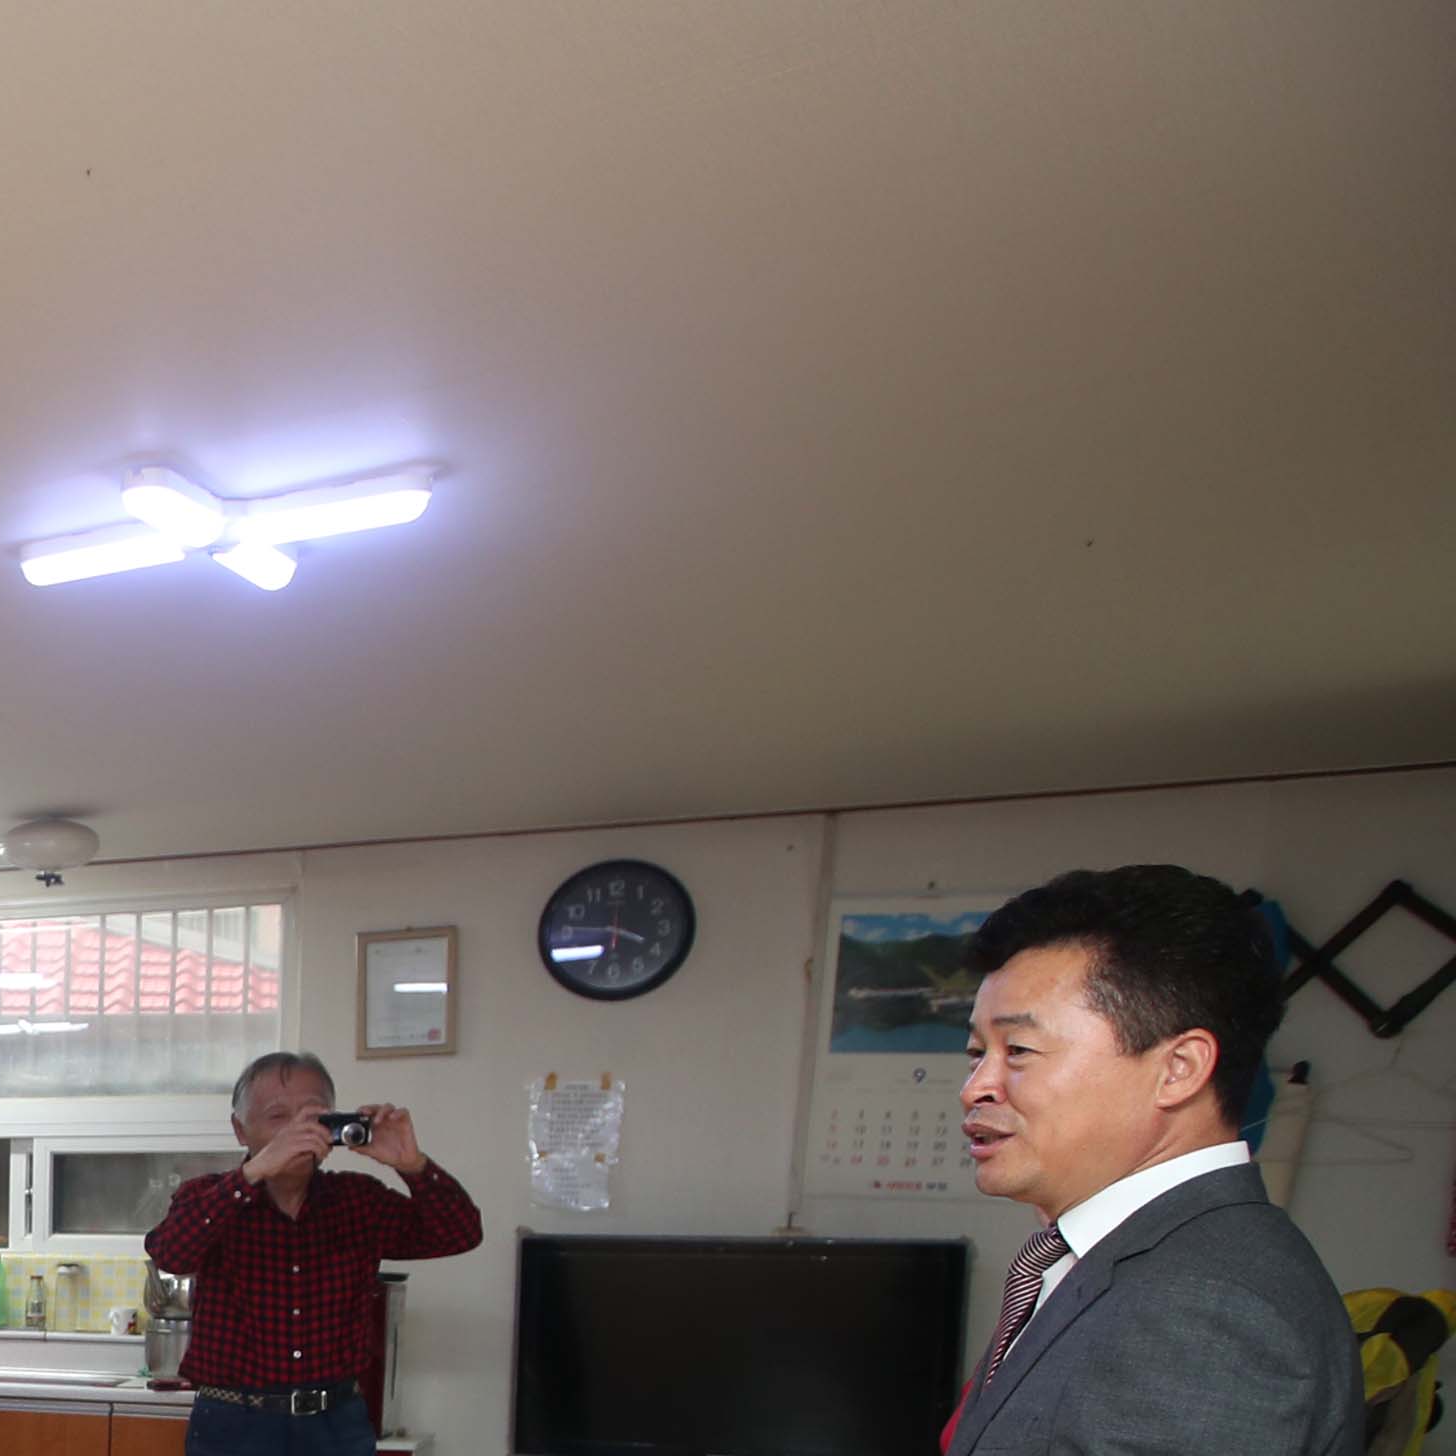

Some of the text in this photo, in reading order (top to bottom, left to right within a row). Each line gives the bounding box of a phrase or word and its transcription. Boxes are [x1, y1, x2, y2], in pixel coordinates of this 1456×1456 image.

[587, 887, 601, 904] 11
[607, 879, 626, 897] 12
[567, 903, 586, 920] 10
[913, 1067, 927, 1083] 9
